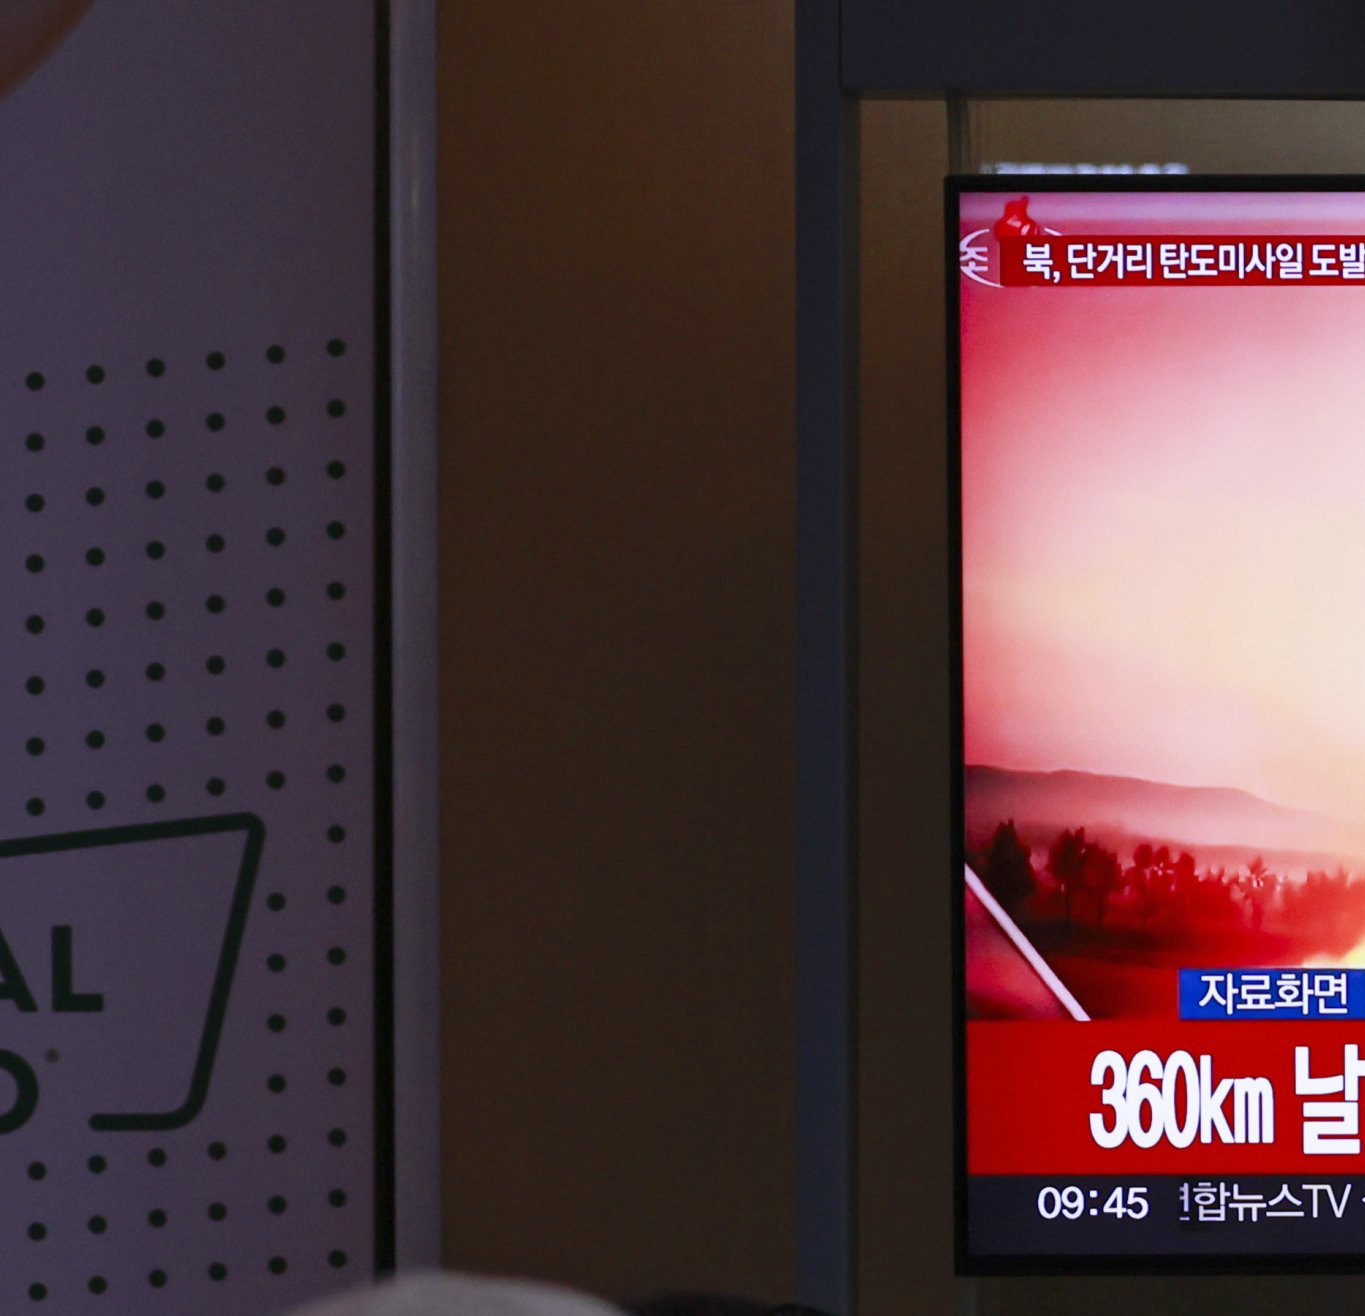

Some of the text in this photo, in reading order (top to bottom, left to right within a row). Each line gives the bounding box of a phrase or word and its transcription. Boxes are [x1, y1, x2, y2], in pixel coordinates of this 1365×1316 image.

[1024, 244, 1060, 282] 북,
[1068, 243, 1151, 279] 단거리
[1160, 243, 1302, 278] 탄도미사일
[1199, 973, 1347, 1014] 자료화면
[1090, 1050, 1273, 1148] 360km
[1038, 1186, 1148, 1219] 09:45
